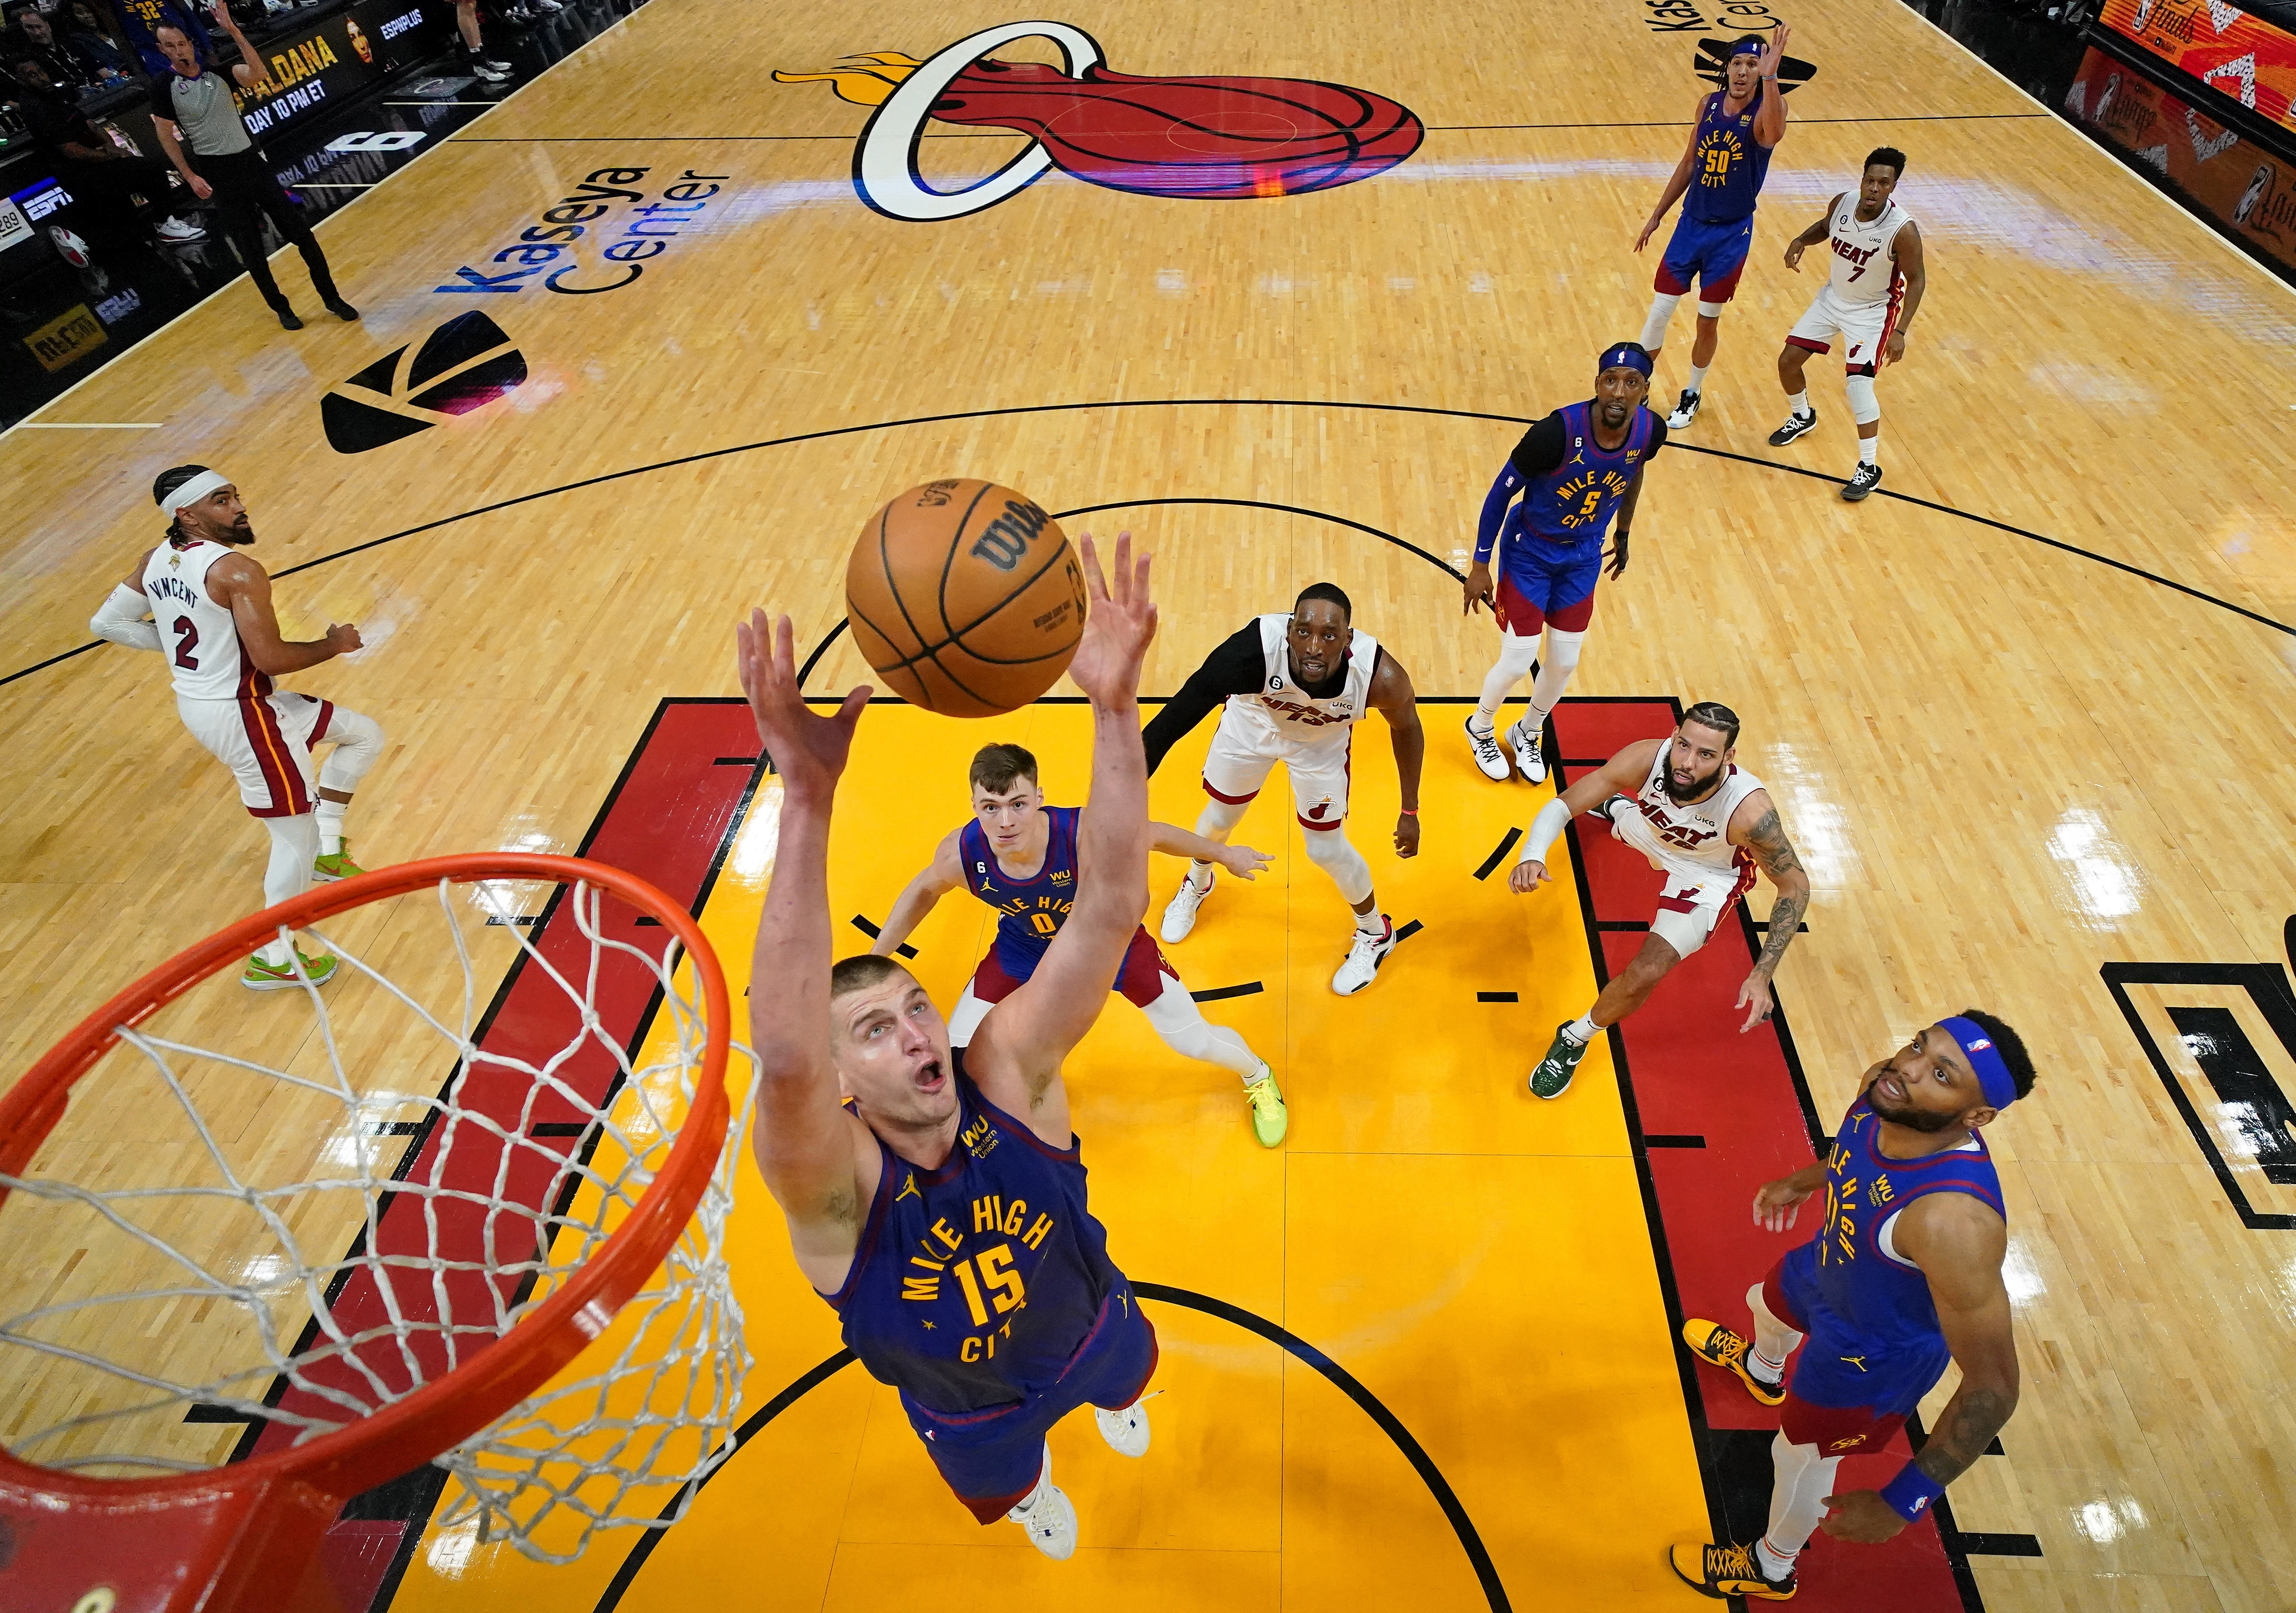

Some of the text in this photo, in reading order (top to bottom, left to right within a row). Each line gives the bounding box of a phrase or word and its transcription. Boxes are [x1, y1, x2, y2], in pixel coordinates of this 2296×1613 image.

[135, 1, 161, 20] 32
[380, 9, 423, 40] ESPNPLUS
[271, 98, 291, 120] 10
[286, 87, 312, 112] PM
[306, 79, 326, 101] ET
[1698, 130, 1743, 161] MILE HIGH
[1705, 149, 1730, 173] 50
[1701, 173, 1726, 188] CITY
[22, 186, 74, 221] ESPN
[433, 167, 652, 293] Kaseya
[544, 170, 730, 294] Center
[1841, 215, 1847, 224] 6
[1831, 236, 1880, 266] HEAT
[1847, 266, 1866, 283] 7
[1575, 437, 1582, 448] 6
[1626, 449, 1640, 457] WU
[1556, 471, 1627, 500] MILE HIGH
[1579, 491, 1602, 514] 5
[148, 577, 198, 609] VINCENT
[173, 615, 199, 671] 2
[1272, 677, 1281, 689] 6
[1332, 701, 1353, 710] UKG
[1655, 779, 1662, 791] 6
[1638, 799, 1718, 845] HEAT
[1695, 814, 1715, 827] UKG
[977, 861, 986, 873] 6
[1049, 869, 1071, 881] WU
[998, 897, 1074, 917] ILE HIG
[1031, 913, 1056, 933] 0
[961, 1115, 988, 1147] WU
[971, 1130, 997, 1157] Western
[978, 1139, 999, 1159] Union
[1868, 1190, 1876, 1207] Union
[1870, 1181, 1882, 1207] Western
[1876, 1173, 1895, 1202] WU
[1838, 1177, 1857, 1260] HIGH
[901, 1195, 1053, 1301] MILE HIGH
[953, 1244, 1026, 1327] 15
